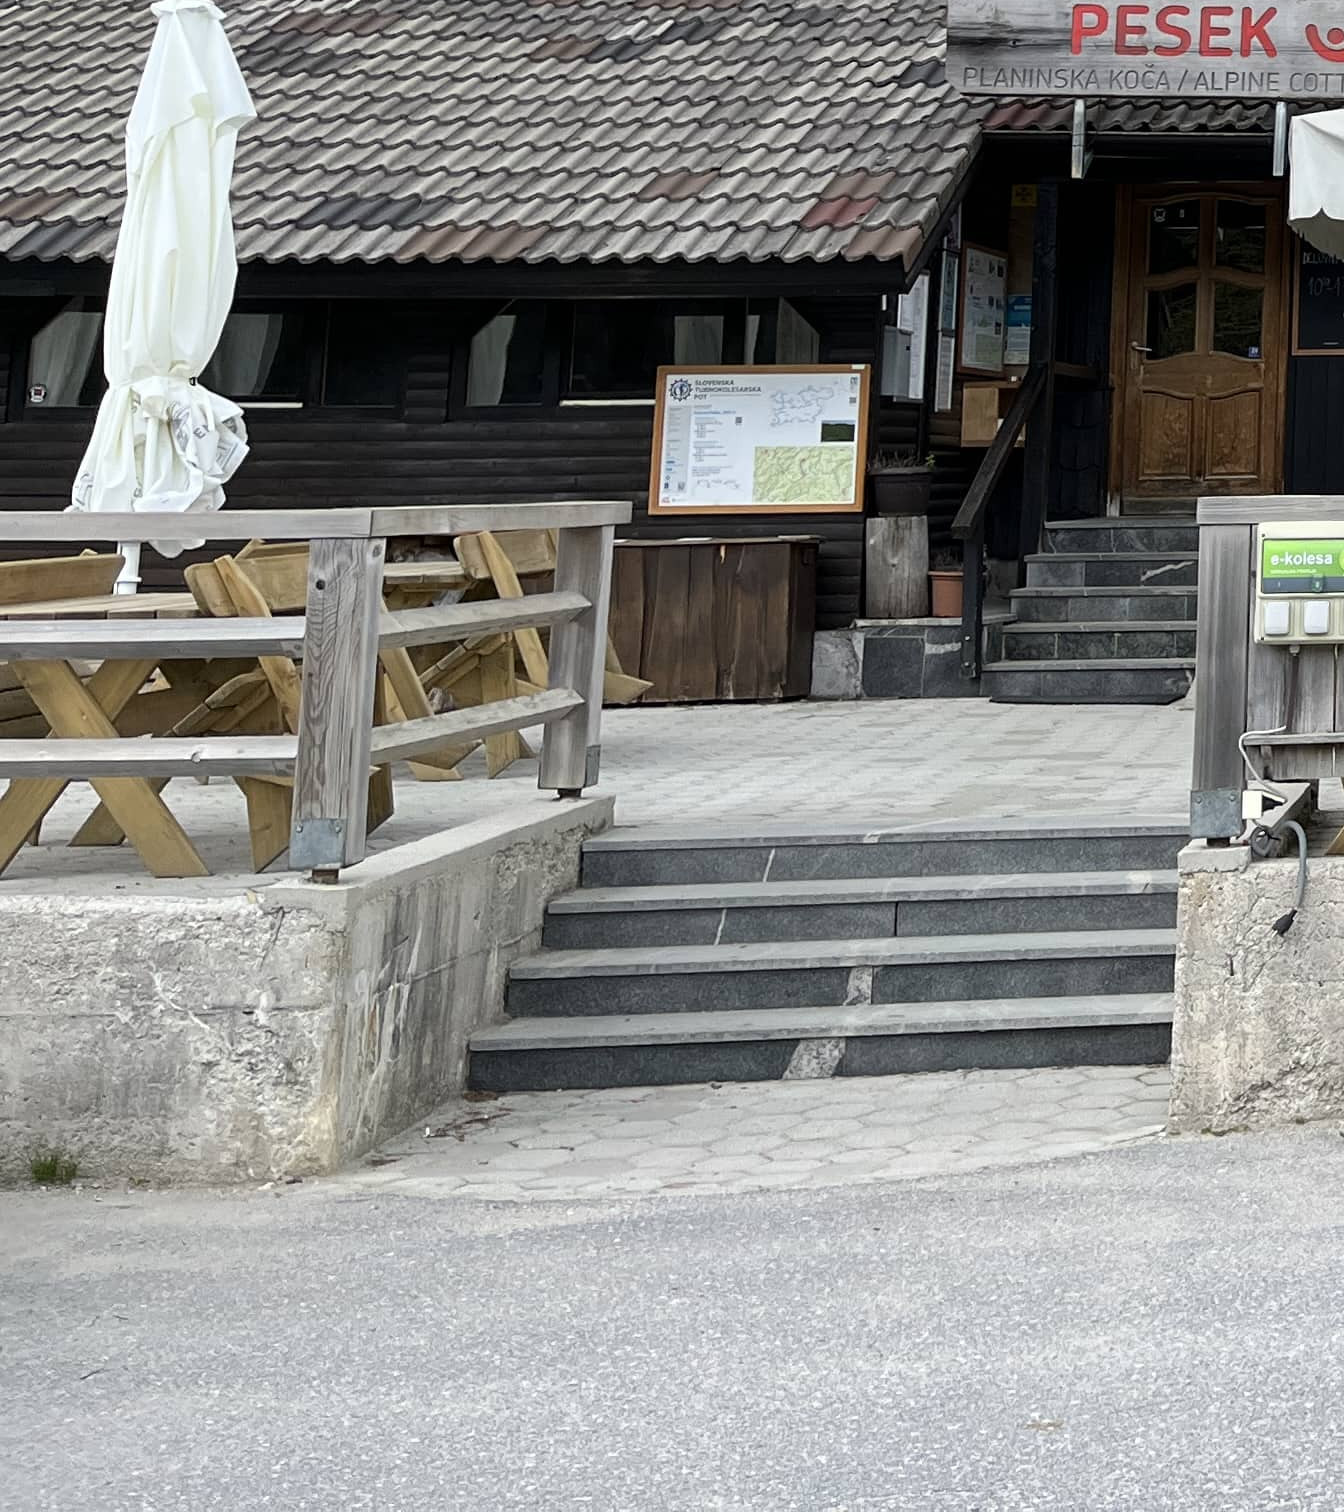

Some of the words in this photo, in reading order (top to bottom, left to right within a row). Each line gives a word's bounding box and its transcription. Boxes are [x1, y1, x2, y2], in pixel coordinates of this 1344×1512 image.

[1070, 3, 1277, 57] PESEK
[963, 66, 1099, 88] PLANINSKA
[1108, 63, 1170, 90] KOČA
[1193, 71, 1281, 92] ALPINE
[1270, 551, 1333, 566] e-kolesa
